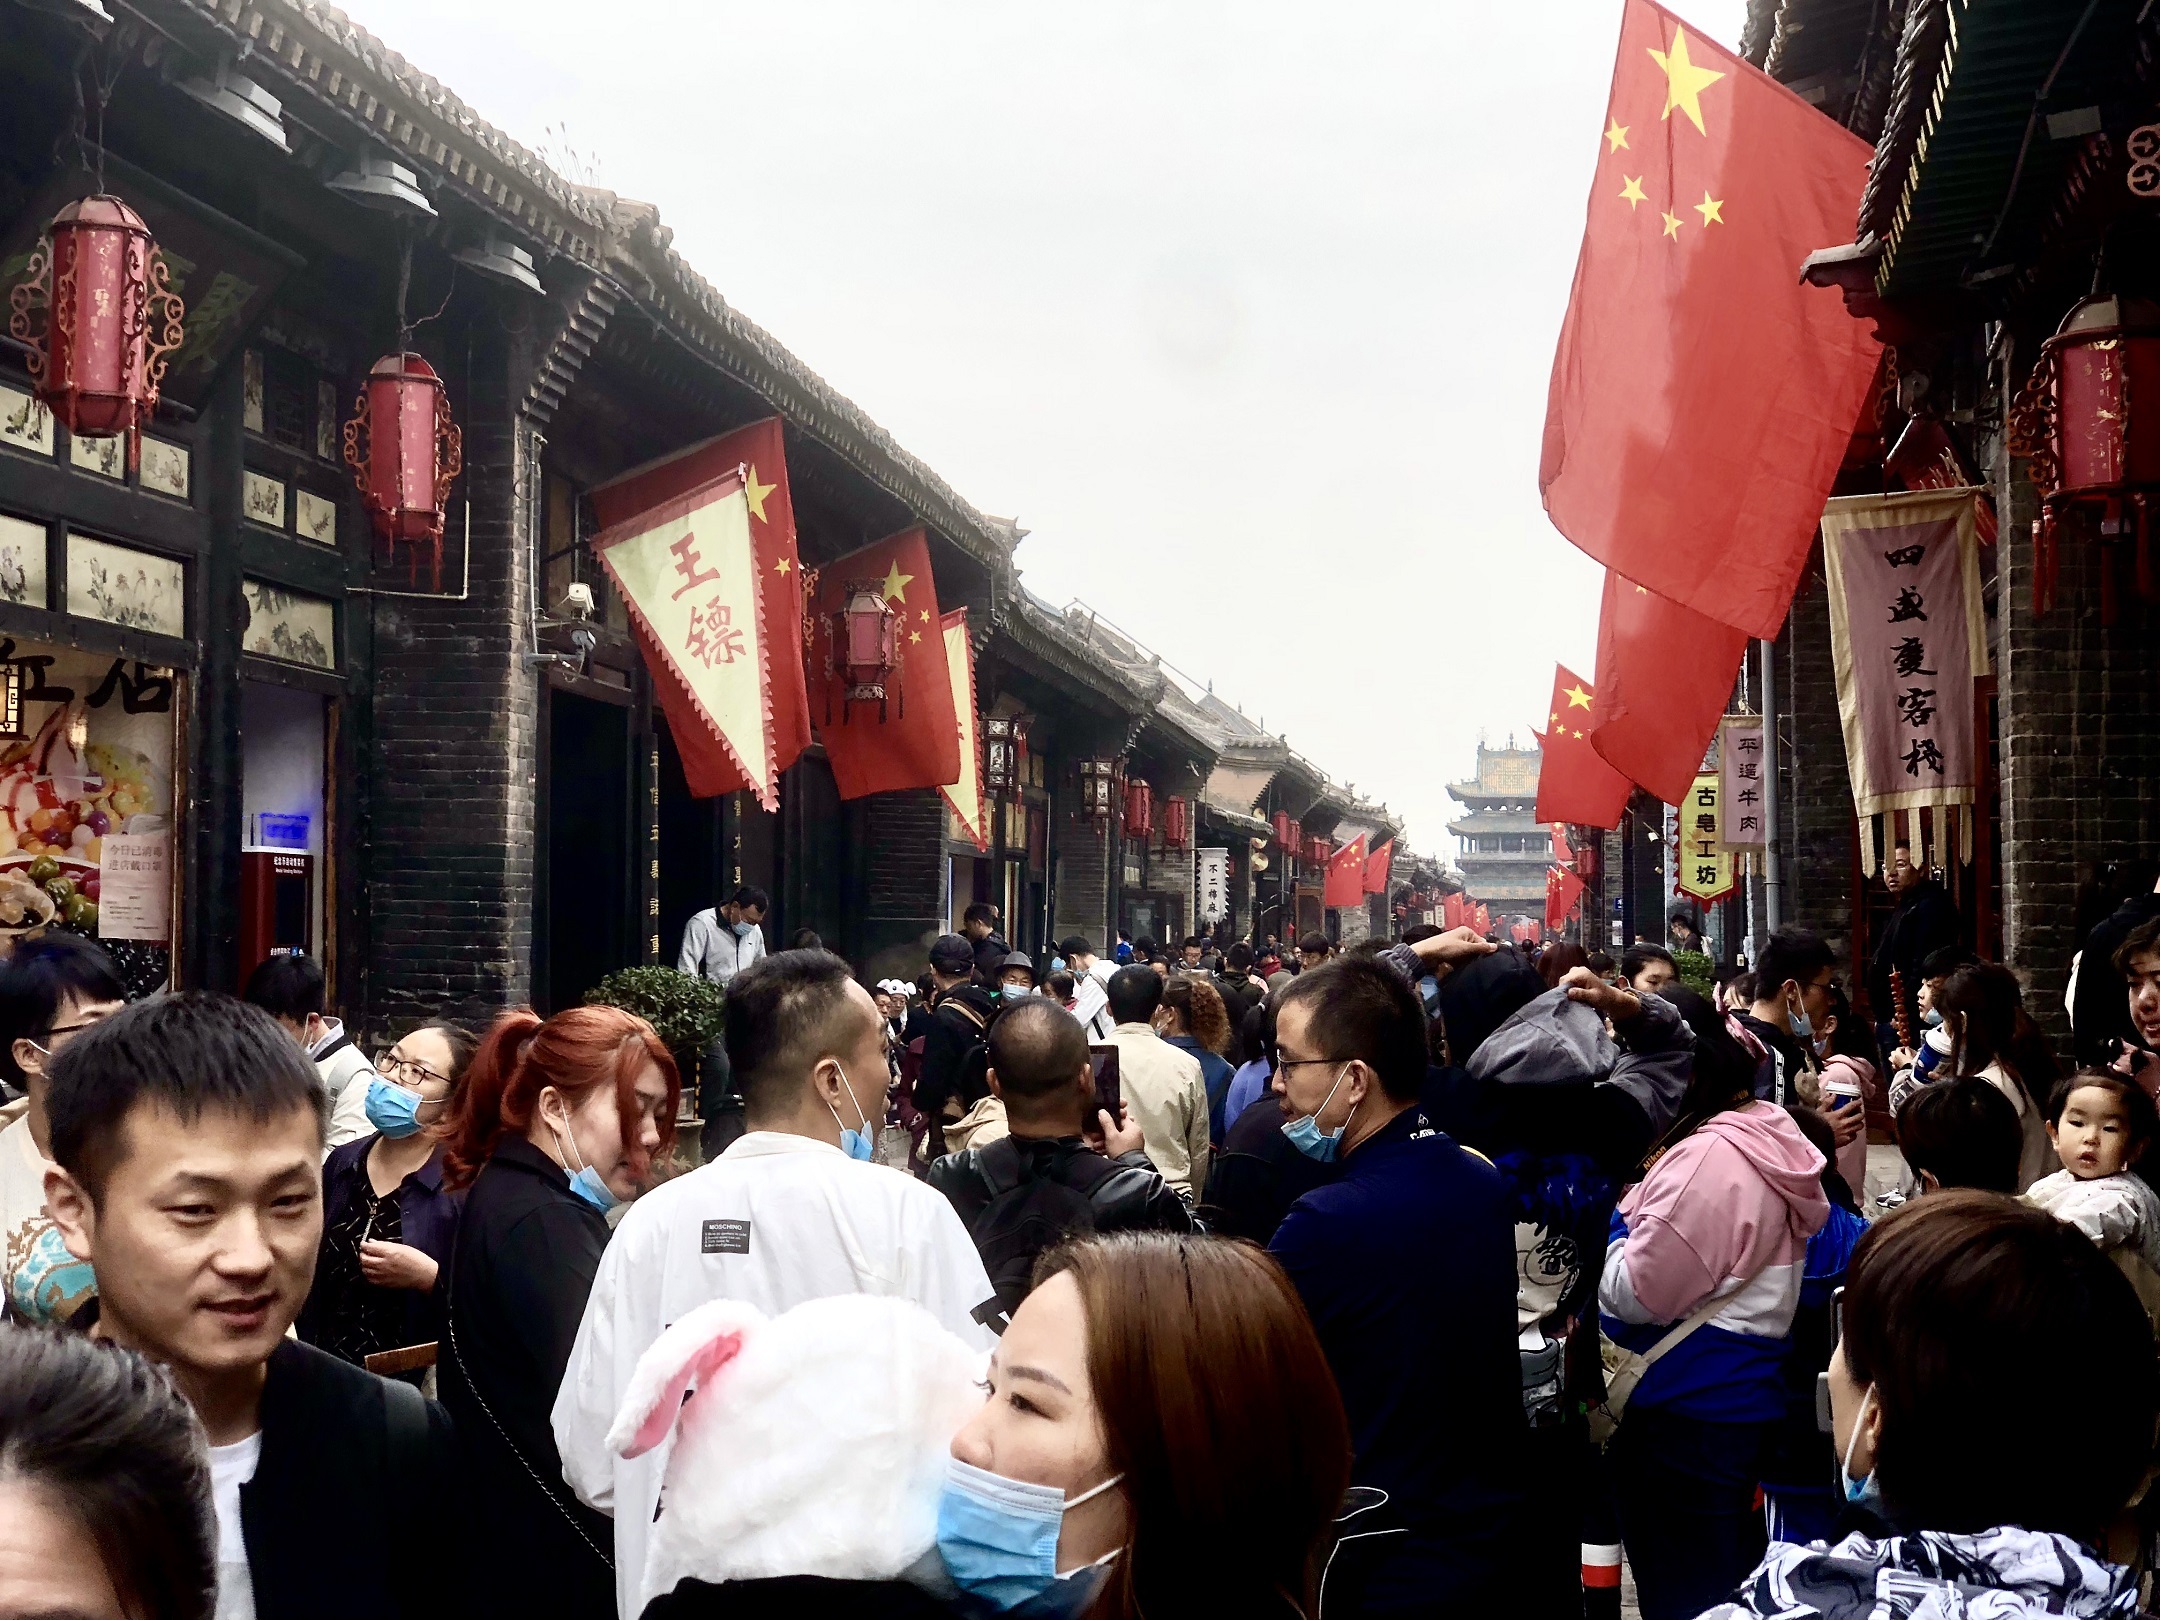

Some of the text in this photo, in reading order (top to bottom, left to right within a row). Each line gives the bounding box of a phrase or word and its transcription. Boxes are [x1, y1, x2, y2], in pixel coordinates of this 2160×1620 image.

[669, 531, 746, 670] 王镖
[1696, 787, 1717, 885] 古皂工坊
[1643, 1146, 1667, 1171] Nikon
